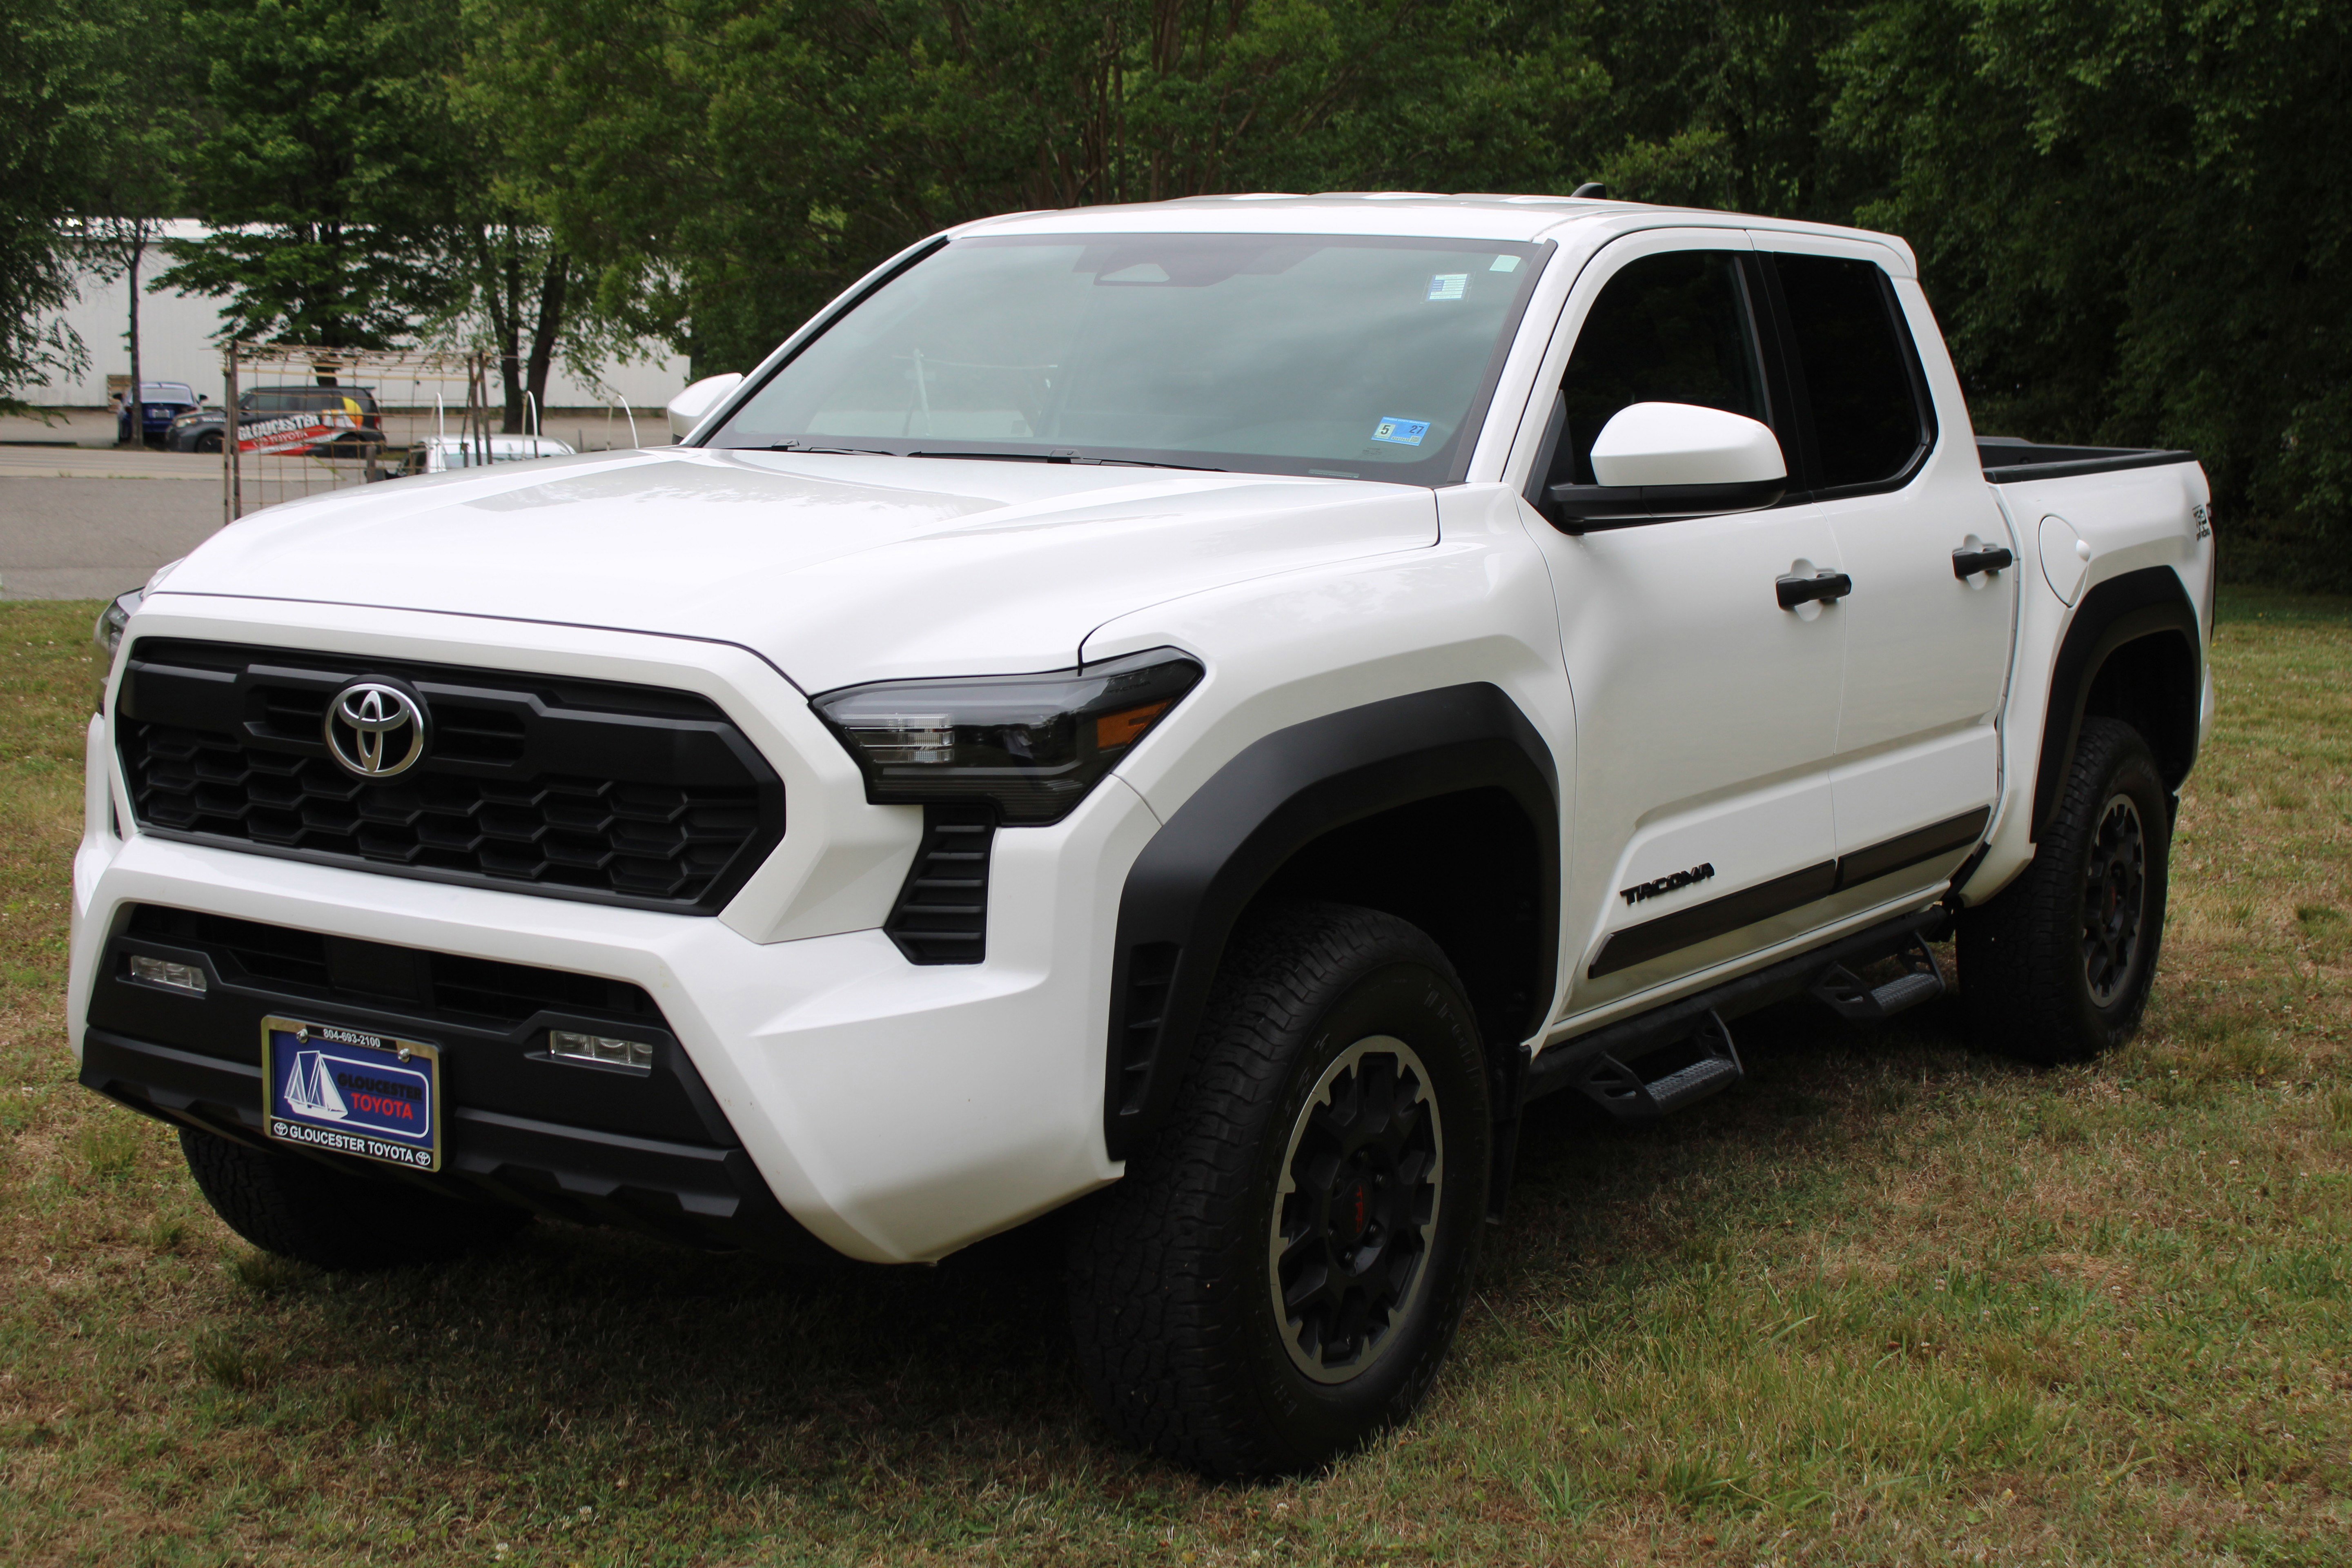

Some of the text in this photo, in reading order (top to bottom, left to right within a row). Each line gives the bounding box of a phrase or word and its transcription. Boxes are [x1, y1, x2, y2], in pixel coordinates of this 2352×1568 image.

[1381, 425, 1391, 435] 5
[1409, 425, 1425, 434] 27
[1619, 862, 1715, 905] TACOMA
[323, 1028, 381, 1048] 804-693-2100
[337, 1072, 423, 1100] GLOUCESTER
[350, 1092, 414, 1120] TOYOTA
[290, 1125, 414, 1163] GLOUCESTER TOYOTA
